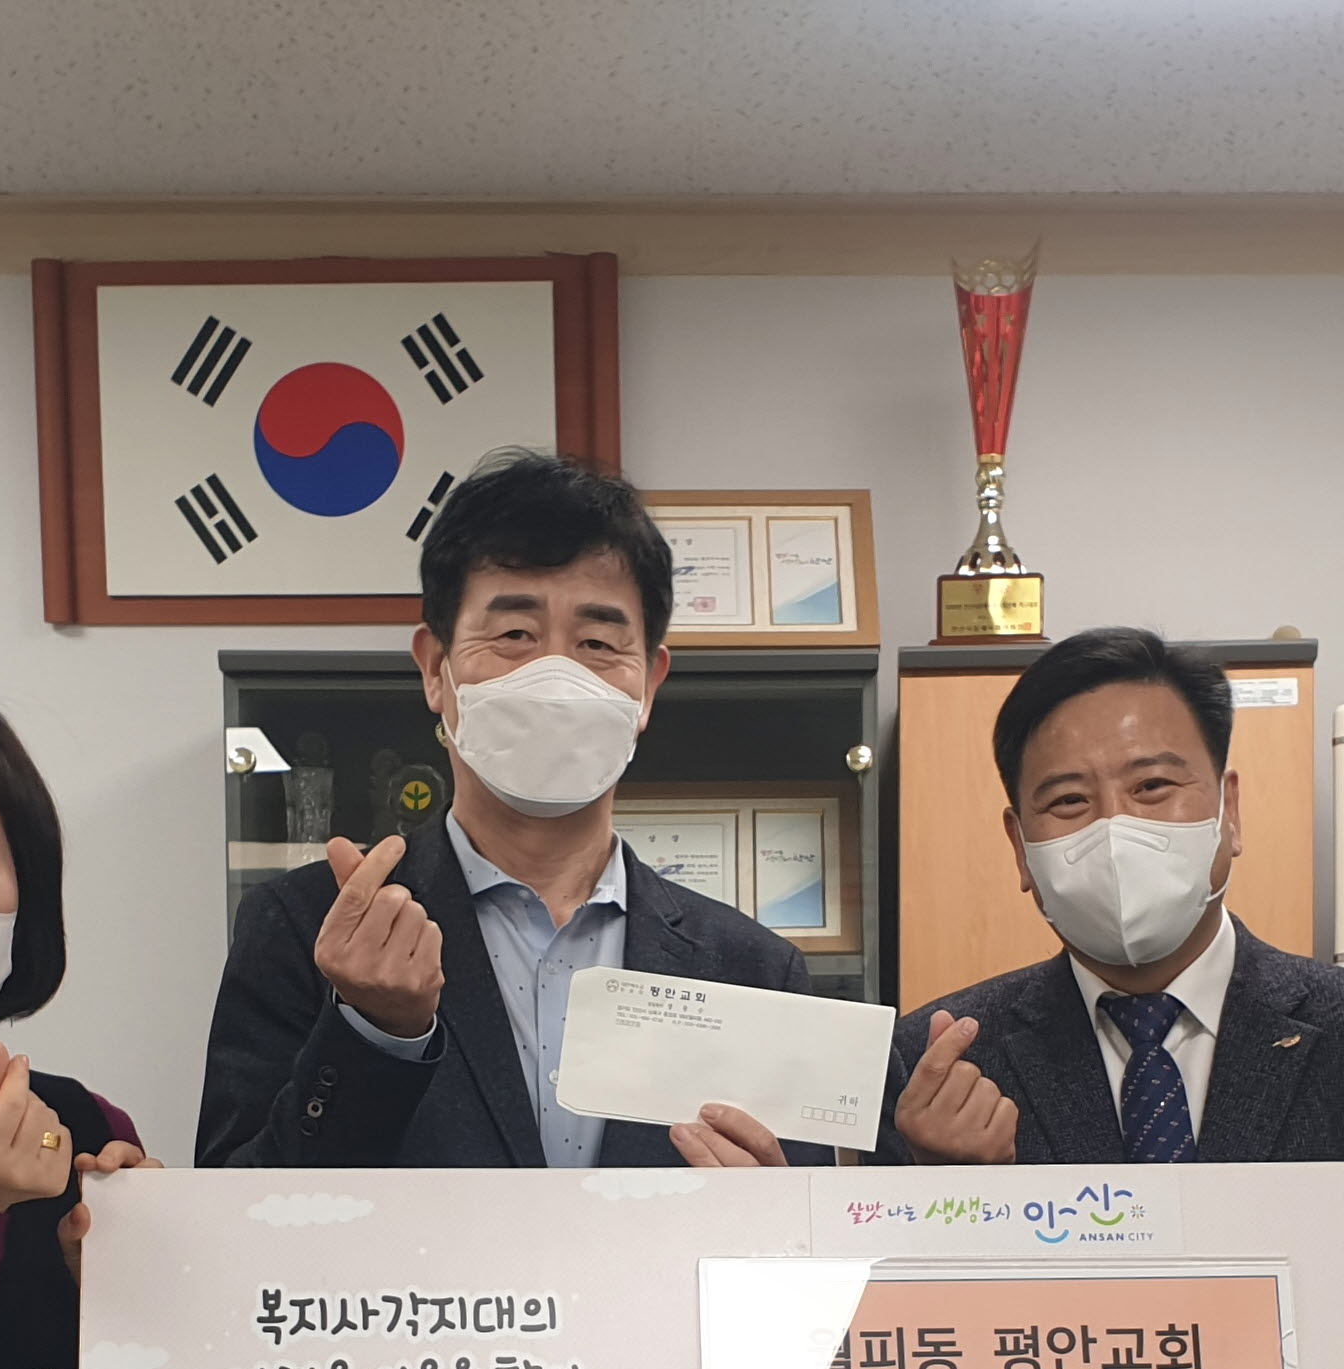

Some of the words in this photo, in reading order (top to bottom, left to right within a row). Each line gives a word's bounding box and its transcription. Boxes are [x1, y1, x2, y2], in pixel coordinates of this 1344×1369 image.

[650, 986, 707, 1004] 평안교회
[838, 1095, 859, 1106] 귀하
[847, 1201, 884, 1224] 살맛
[887, 1203, 917, 1222] 나는
[1079, 1232, 1125, 1242] ANSAN
[1128, 1232, 1154, 1242] CITY
[256, 1288, 557, 1346] 복지사각지대의
